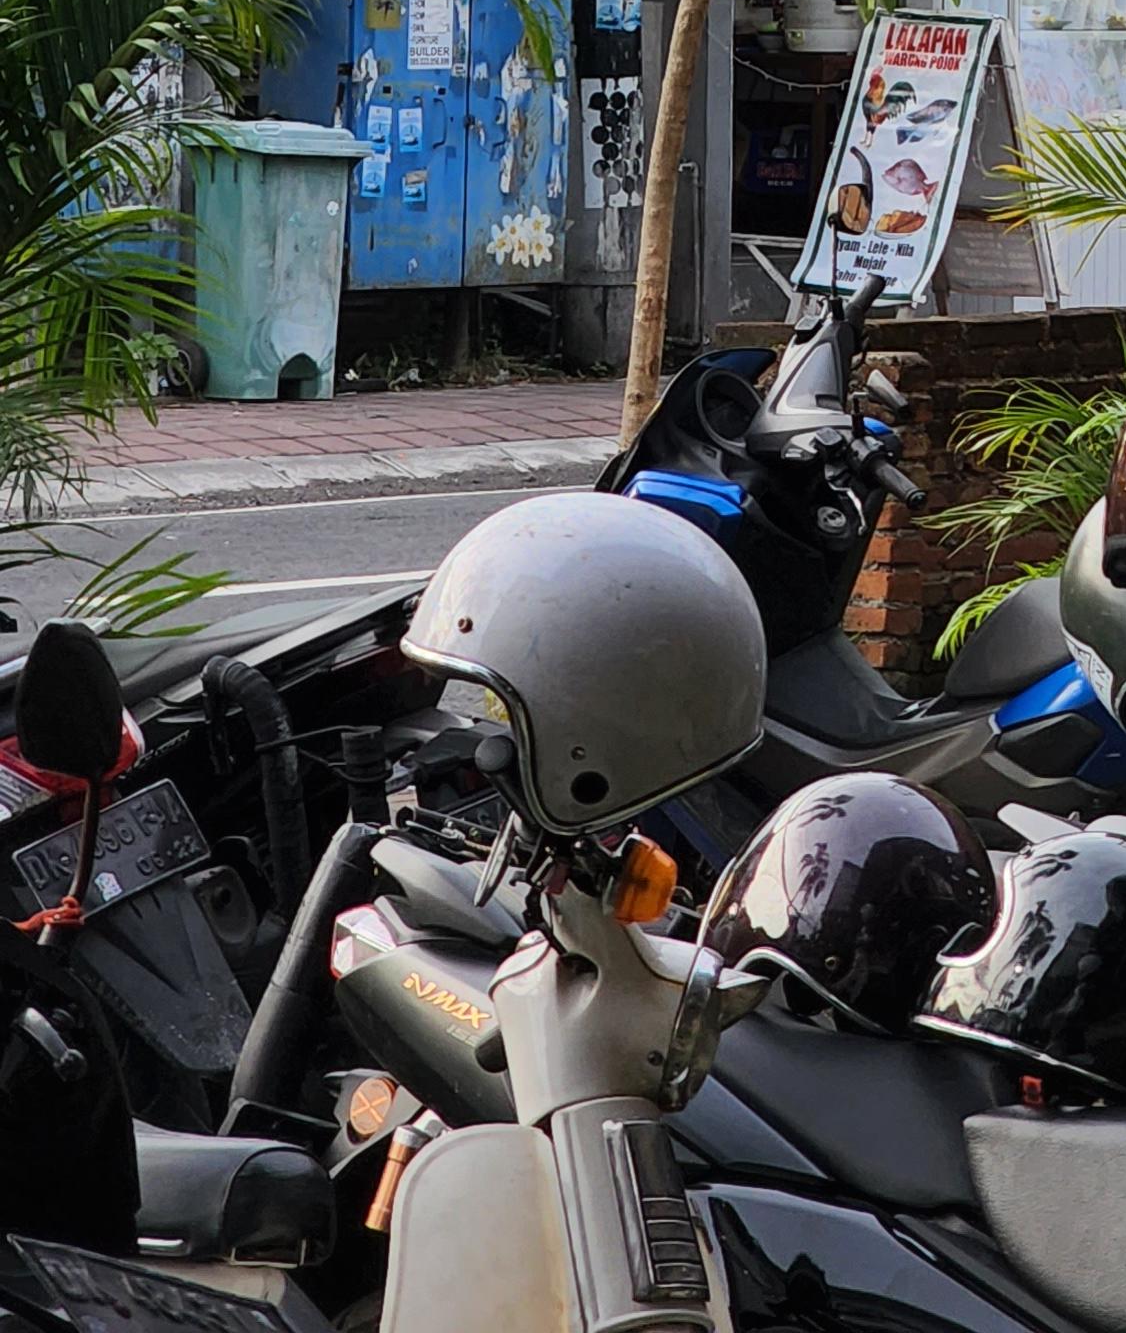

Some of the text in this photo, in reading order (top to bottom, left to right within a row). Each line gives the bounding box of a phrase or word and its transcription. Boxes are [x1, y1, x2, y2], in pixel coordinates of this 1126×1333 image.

[885, 22, 970, 55] LALAPAN
[409, 46, 450, 57] BUILDER
[835, 237, 861, 253] yam
[868, 240, 889, 255] Lele
[853, 254, 888, 271] Mujair
[402, 971, 493, 1030] NMAX
